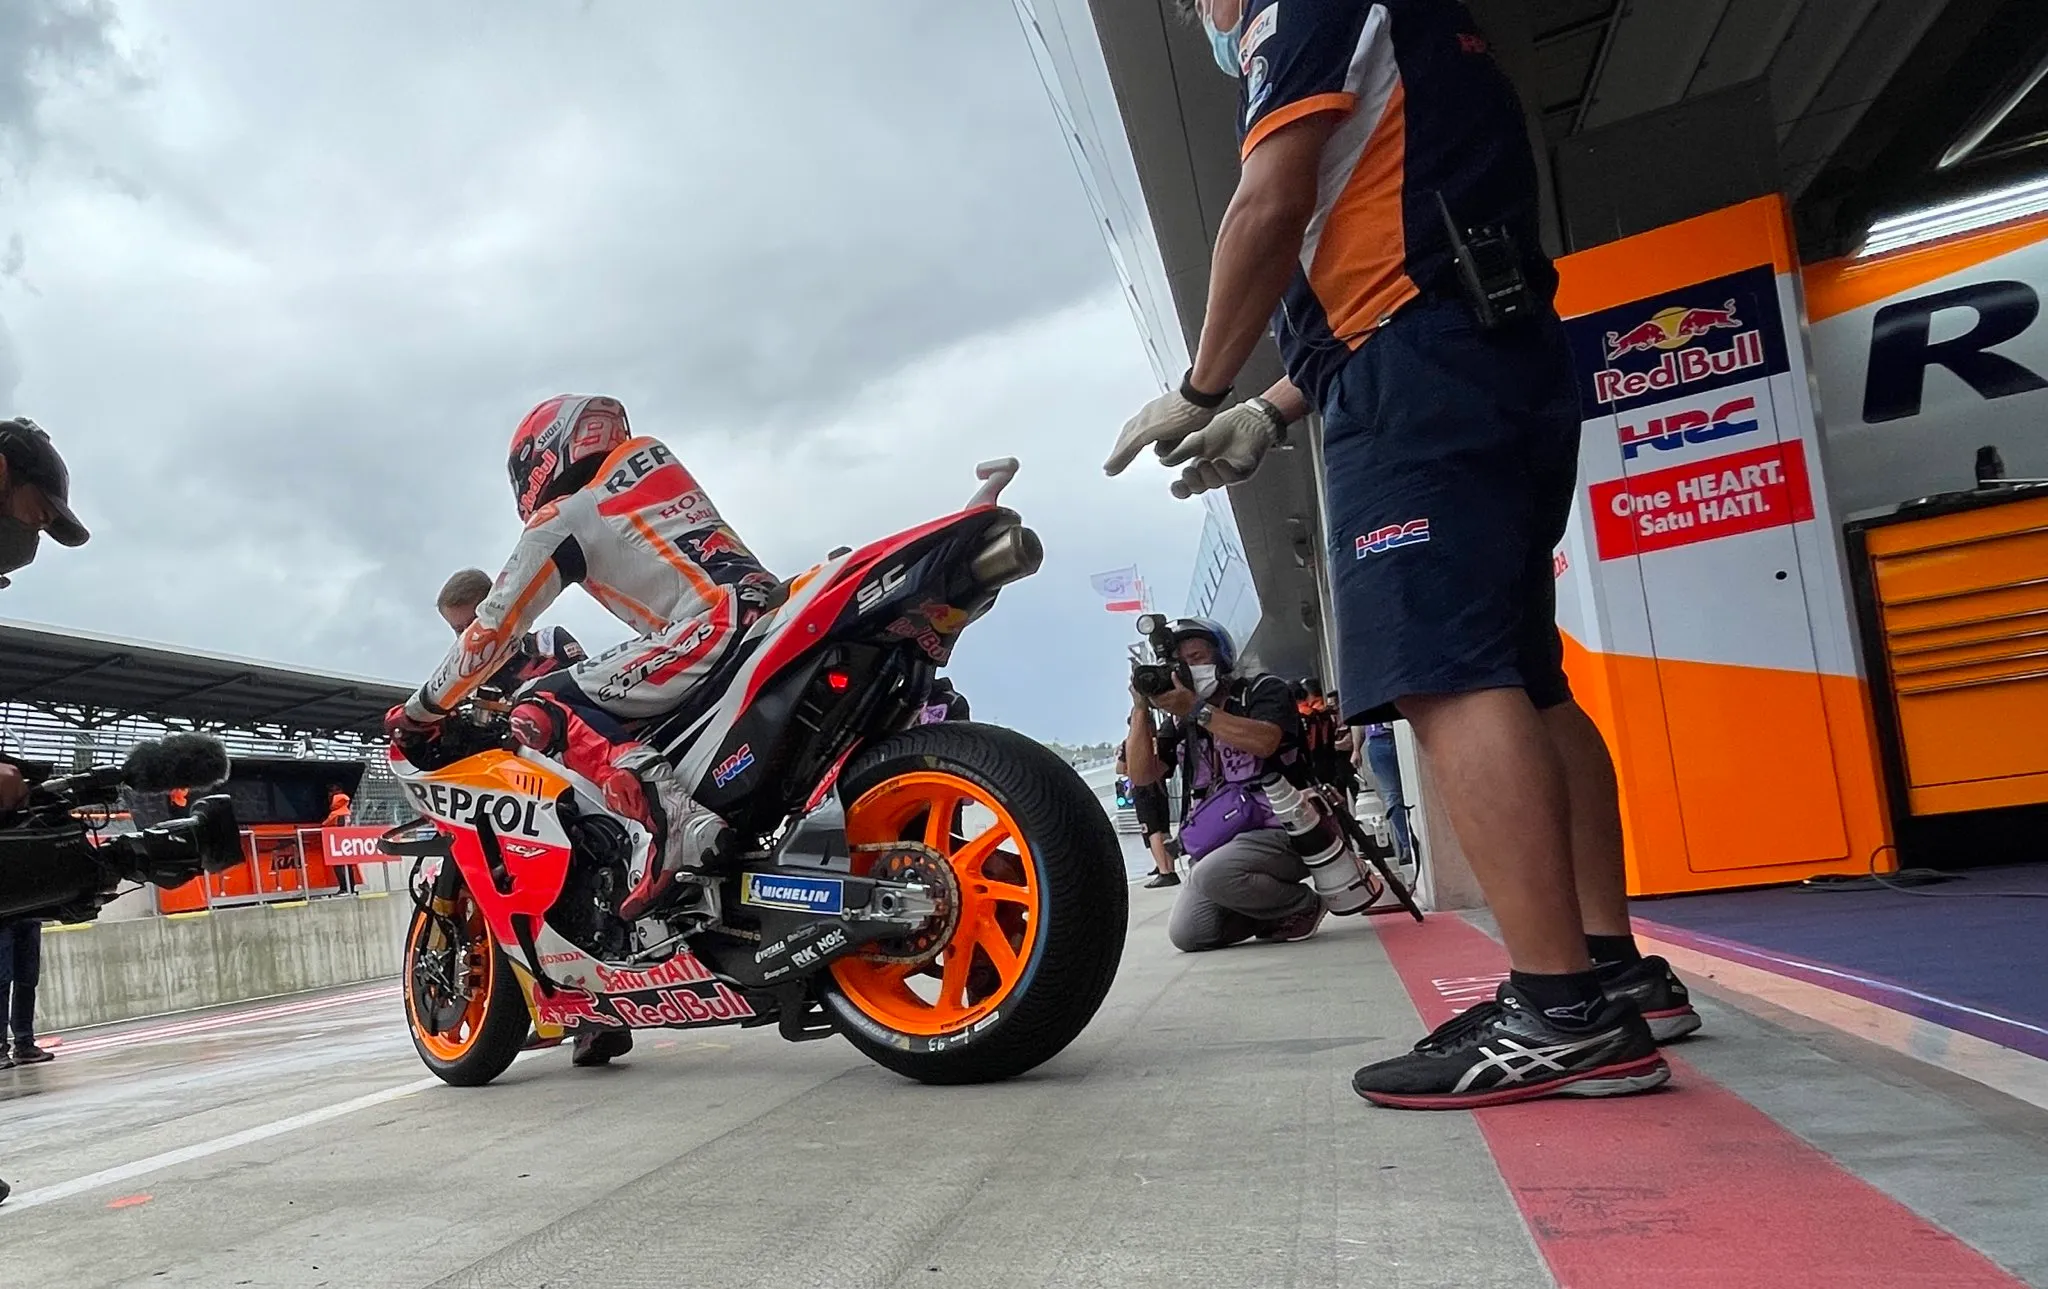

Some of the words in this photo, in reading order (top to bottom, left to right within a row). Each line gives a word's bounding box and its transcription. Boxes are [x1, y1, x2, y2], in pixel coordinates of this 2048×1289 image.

[536, 419, 563, 449] SHOEI
[1618, 396, 1759, 460] HRC
[1611, 489, 1671, 518] One
[1677, 459, 1786, 505] HEART.
[1640, 513, 1695, 538] Satu
[1698, 492, 1771, 526] HATI.
[1355, 519, 1431, 560] HRC
[712, 743, 755, 788] HRC
[406, 782, 540, 837] REPSOL
[761, 885, 830, 904] MICHELIN
[540, 951, 587, 966] HONDA
[791, 946, 820, 967] RK
[816, 928, 845, 952] NGK
